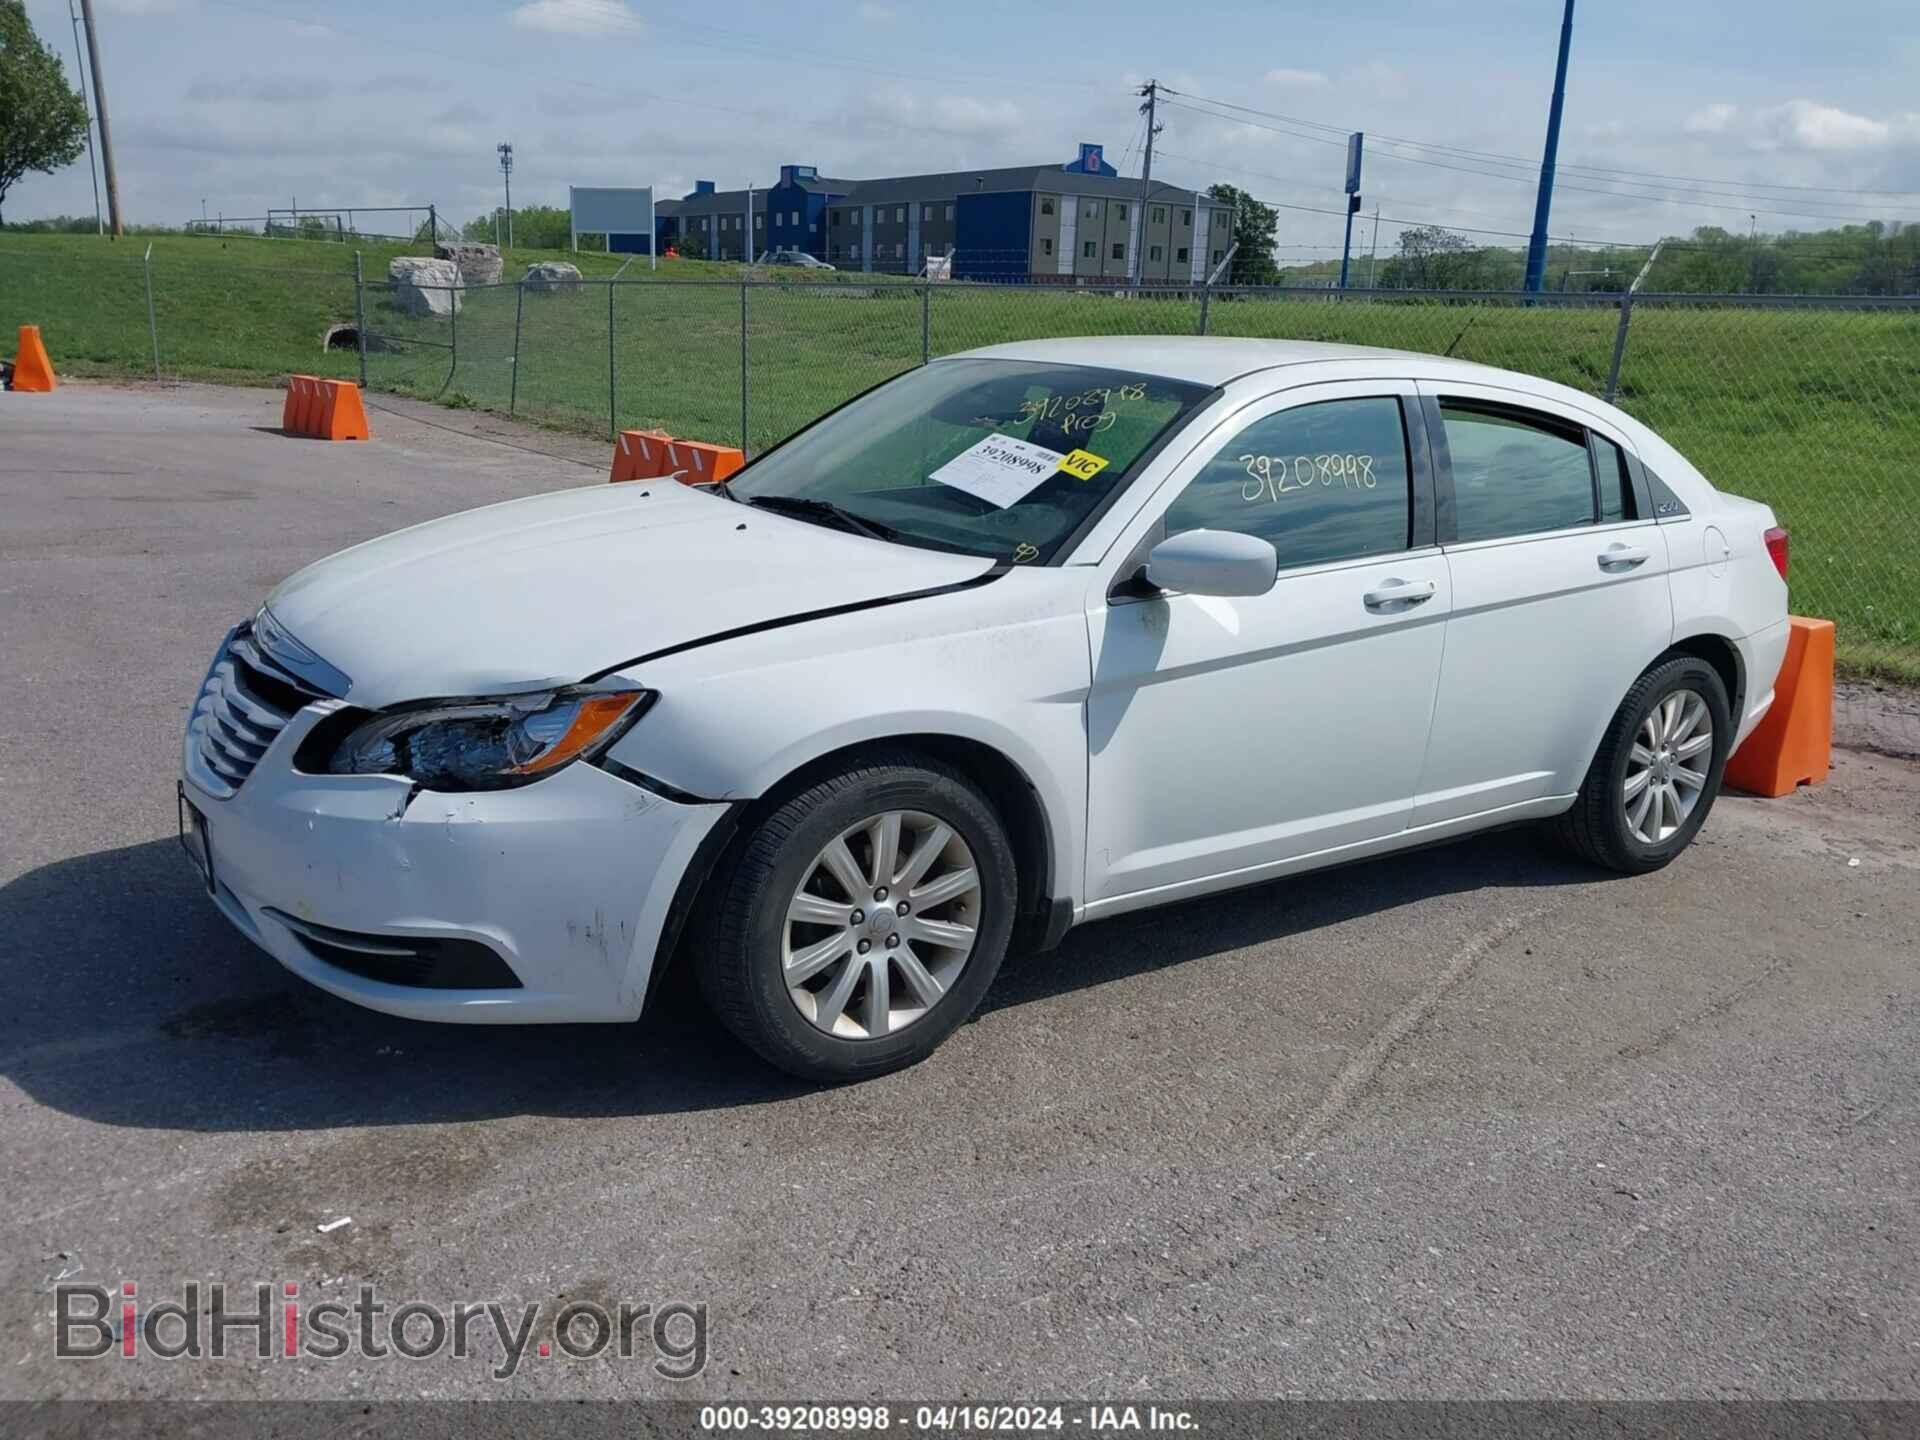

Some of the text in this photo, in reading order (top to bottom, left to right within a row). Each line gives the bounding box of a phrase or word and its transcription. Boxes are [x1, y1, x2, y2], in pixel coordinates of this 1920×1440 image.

[979, 445, 1047, 475] 39208998
[1065, 453, 1099, 475] VIC
[1239, 454, 1377, 502] 39208998
